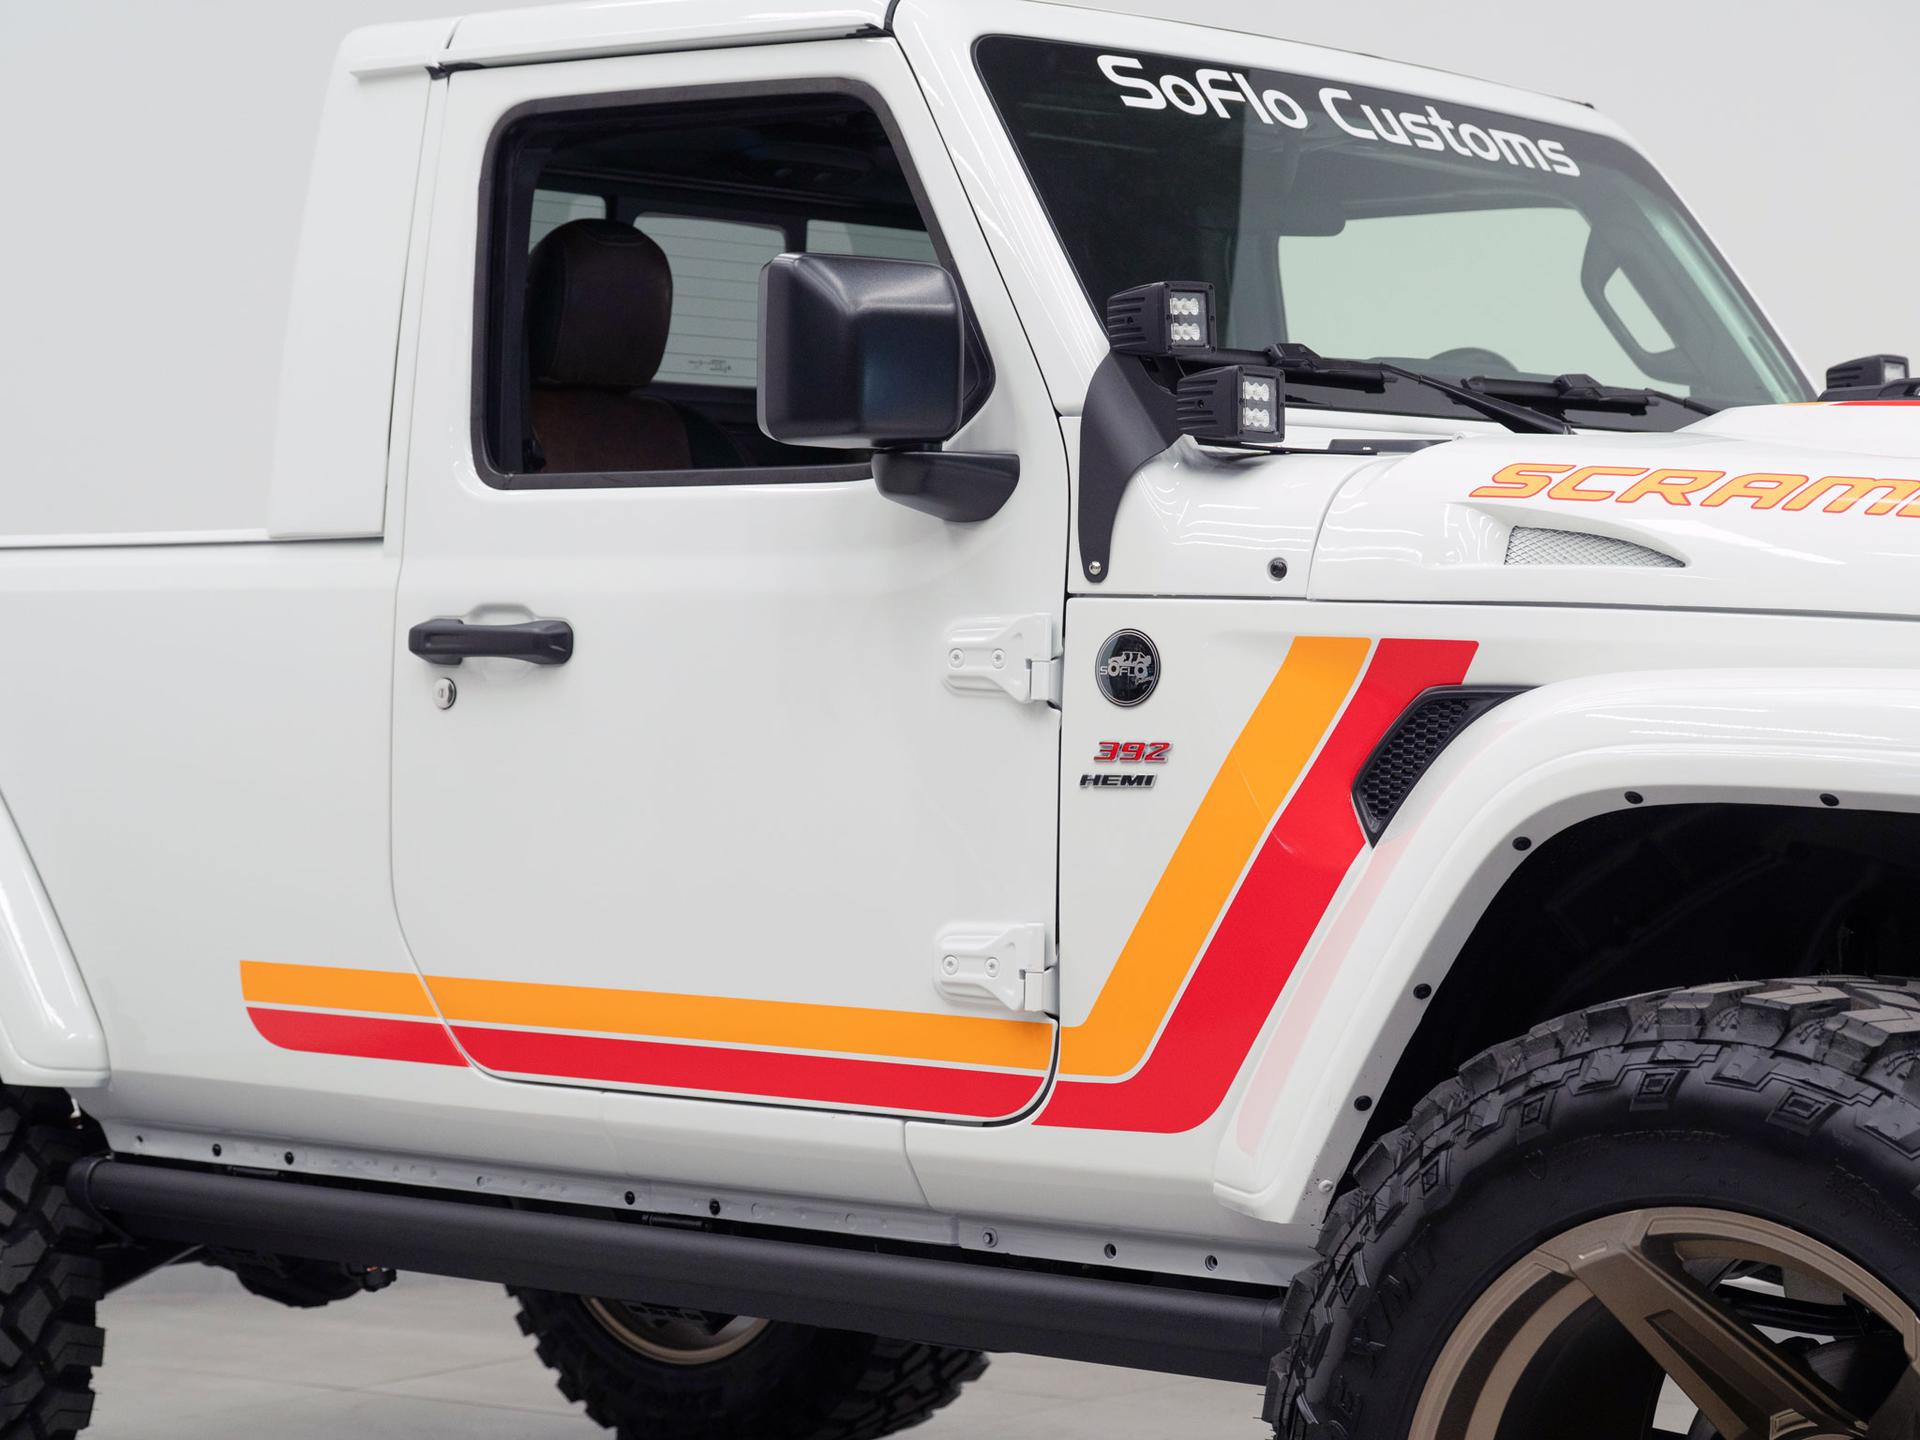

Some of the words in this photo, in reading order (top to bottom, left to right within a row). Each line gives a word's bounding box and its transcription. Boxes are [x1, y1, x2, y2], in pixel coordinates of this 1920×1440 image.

[1096, 54, 1308, 130] SoFlo
[1318, 87, 1581, 177] Customs
[1469, 462, 1920, 517] SCRAM
[1093, 741, 1172, 764] 392
[1080, 774, 1157, 788] HEMI
